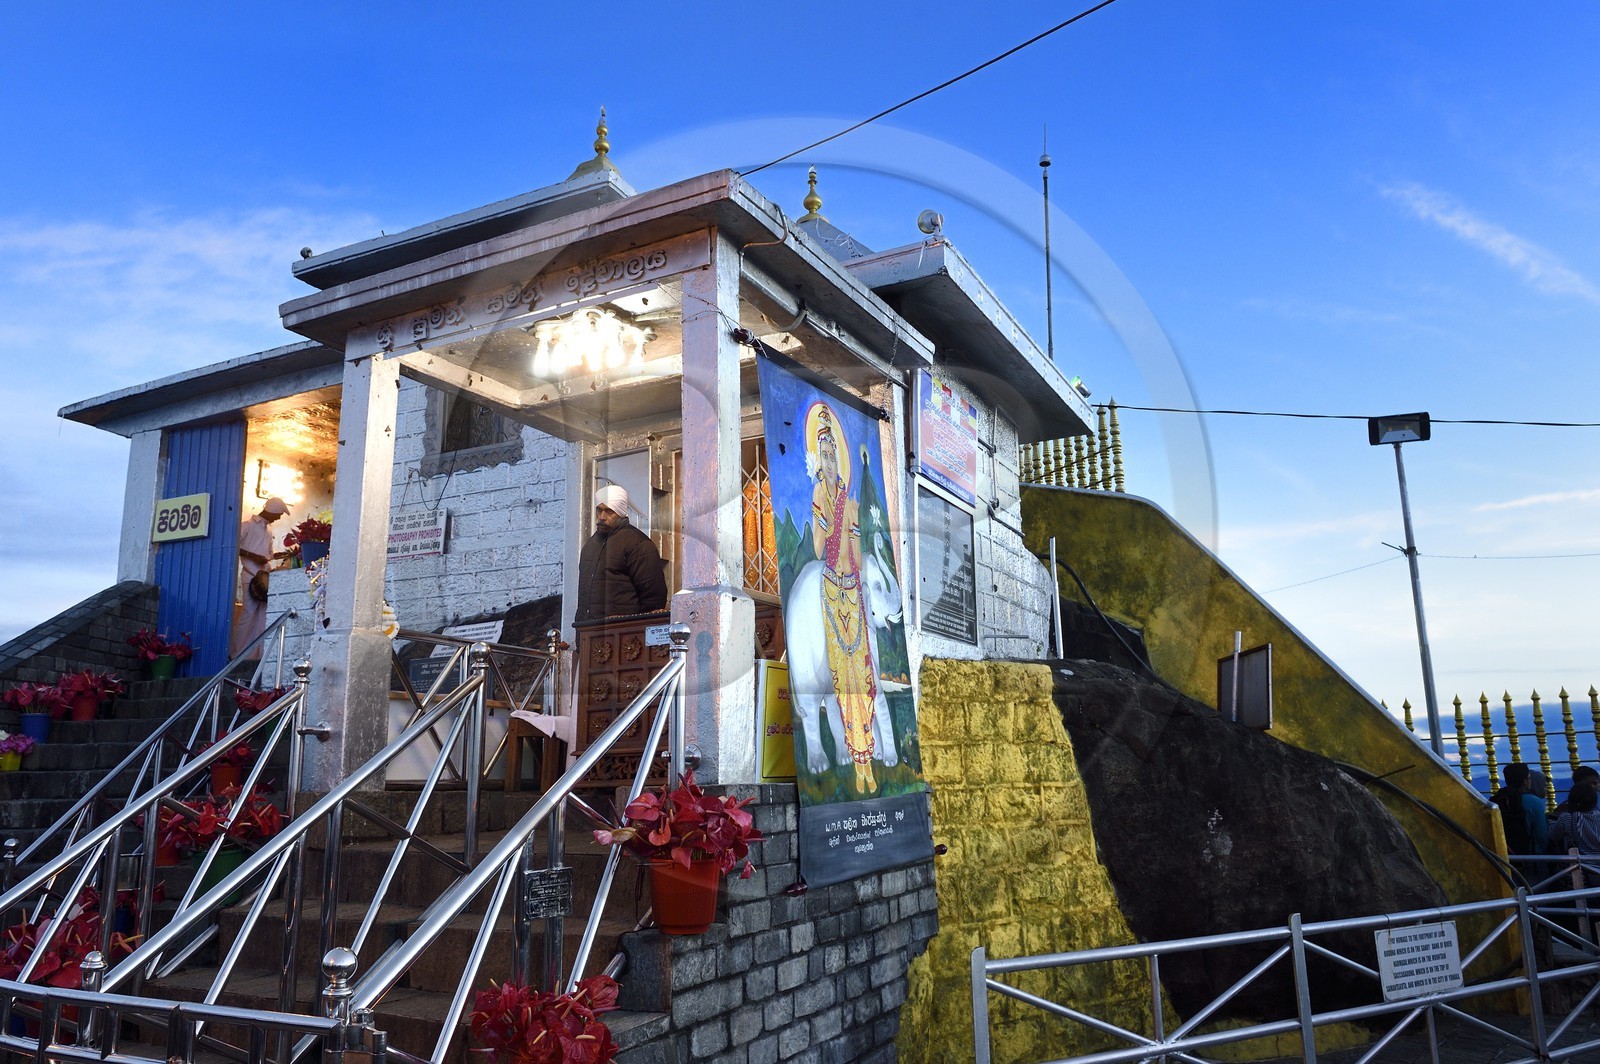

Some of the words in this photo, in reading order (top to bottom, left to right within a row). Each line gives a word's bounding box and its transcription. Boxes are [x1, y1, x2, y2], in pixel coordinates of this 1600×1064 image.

[157, 504, 201, 533] පිටවීම
[388, 531, 418, 543] PHOTOGRAPHY
[418, 528, 442, 540] PROHIBITED
[1418, 932, 1433, 940] FOOTPRINT
[1396, 947, 1406, 955] WHICH
[1408, 957, 1417, 965] WHICH
[1432, 953, 1446, 961] MOUNTAIN
